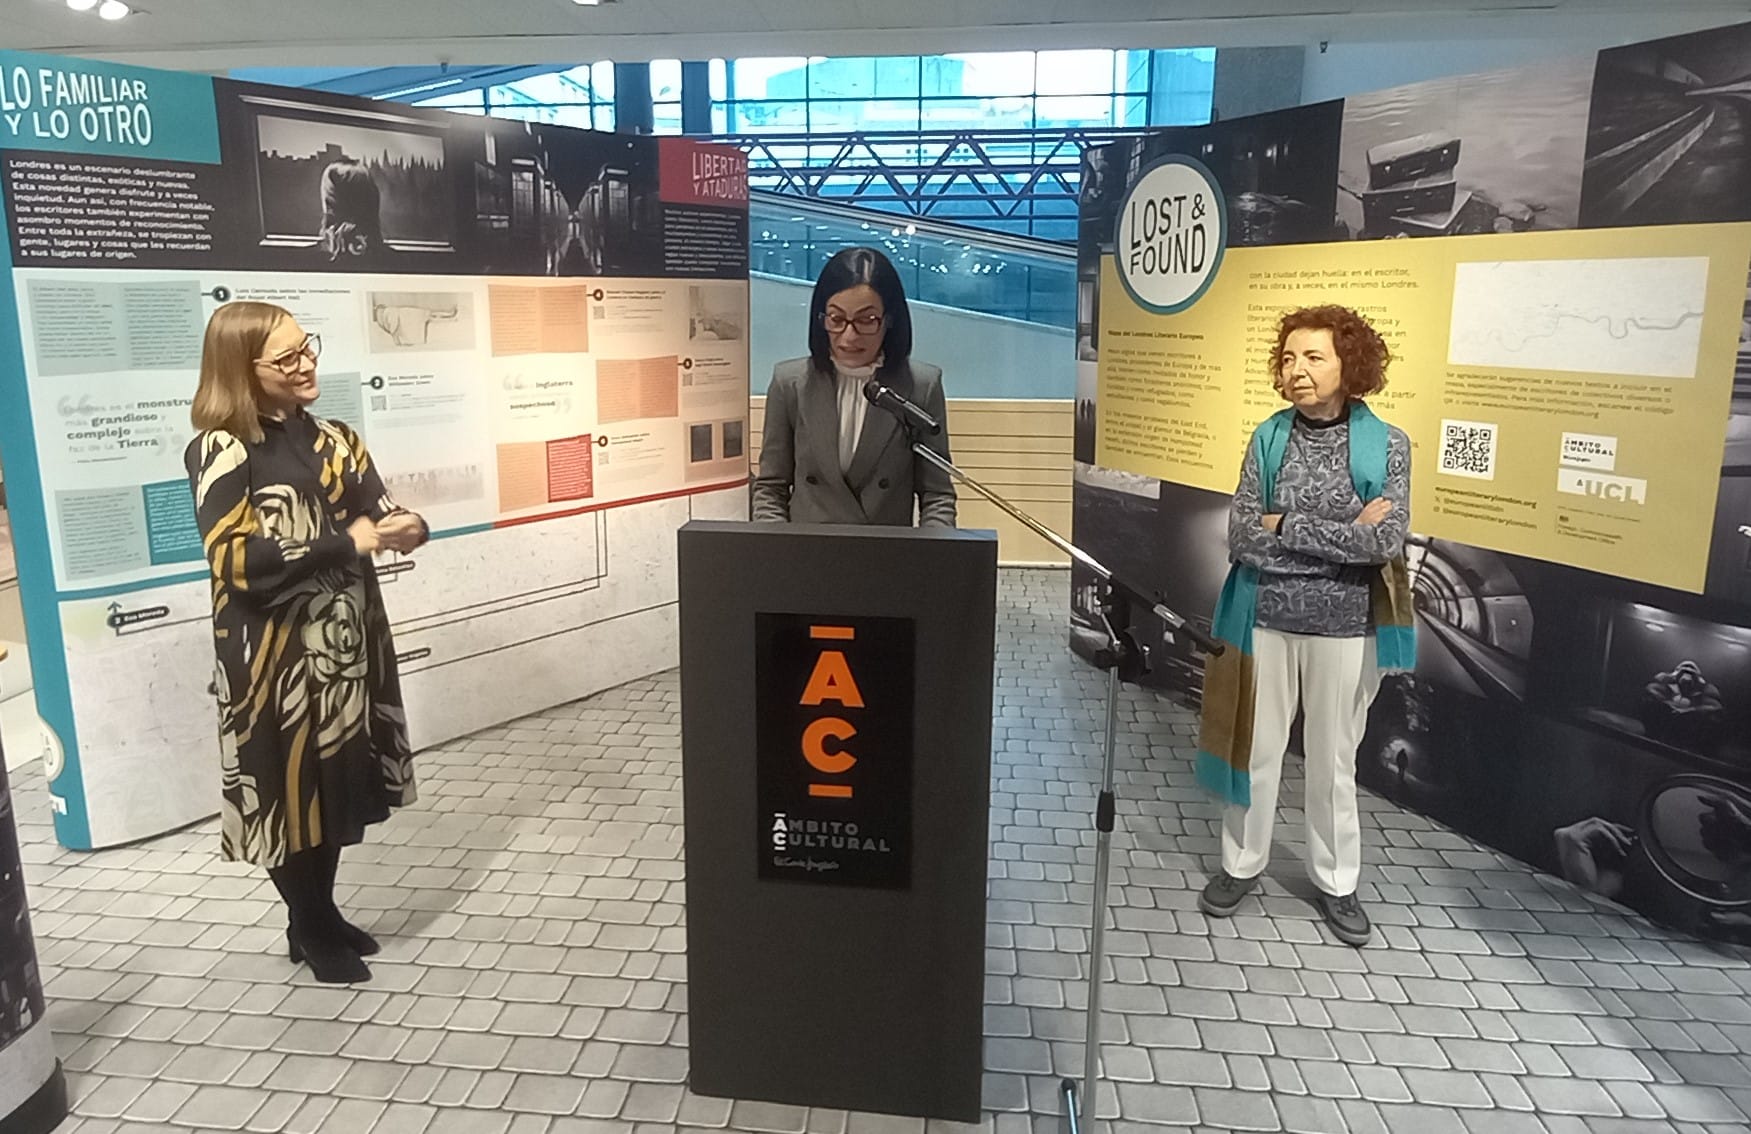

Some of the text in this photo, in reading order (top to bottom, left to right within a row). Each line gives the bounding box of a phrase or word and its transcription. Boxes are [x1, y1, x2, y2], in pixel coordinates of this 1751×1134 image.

[0, 65, 149, 110] LO FAMILIAR
[5, 103, 151, 145] Y LO OTRO
[10, 160, 51, 169] Londres
[85, 165, 131, 175] escenario
[134, 168, 195, 179] deslumbrante
[11, 171, 24, 179] de
[27, 173, 56, 181] cosas
[60, 174, 105, 184] distintas,
[13, 183, 35, 191] Esta
[38, 184, 80, 193] novedad
[84, 187, 116, 195] genera
[119, 188, 155, 197] disfrute
[693, 182, 699, 195] Y
[14, 194, 65, 204] inquietud.
[68, 196, 87, 204] Aun
[130, 199, 177, 209] frecuencia
[34, 206, 83, 214] escritores
[87, 207, 126, 217] también
[129, 209, 190, 220] experimentan
[17, 216, 61, 225] asombro
[1132, 193, 1205, 250] LOST &
[19, 227, 46, 235] Entre
[50, 228, 72, 236] toda
[152, 232, 193, 242] tropiezan
[54, 239, 90, 248] lugares
[151, 241, 164, 249] les
[167, 241, 210, 250] recuerdan
[1131, 224, 1205, 275] FOUND
[51, 249, 87, 259] lugares
[90, 250, 102, 258] de
[137, 399, 192, 409] monstru
[91, 413, 158, 427] grandioso
[67, 427, 130, 440] complejo
[117, 439, 158, 448] Tierra
[1564, 445, 1614, 456] CULTURAL
[1585, 480, 1638, 504] UCL
[773, 833, 890, 851] CULTURAL
